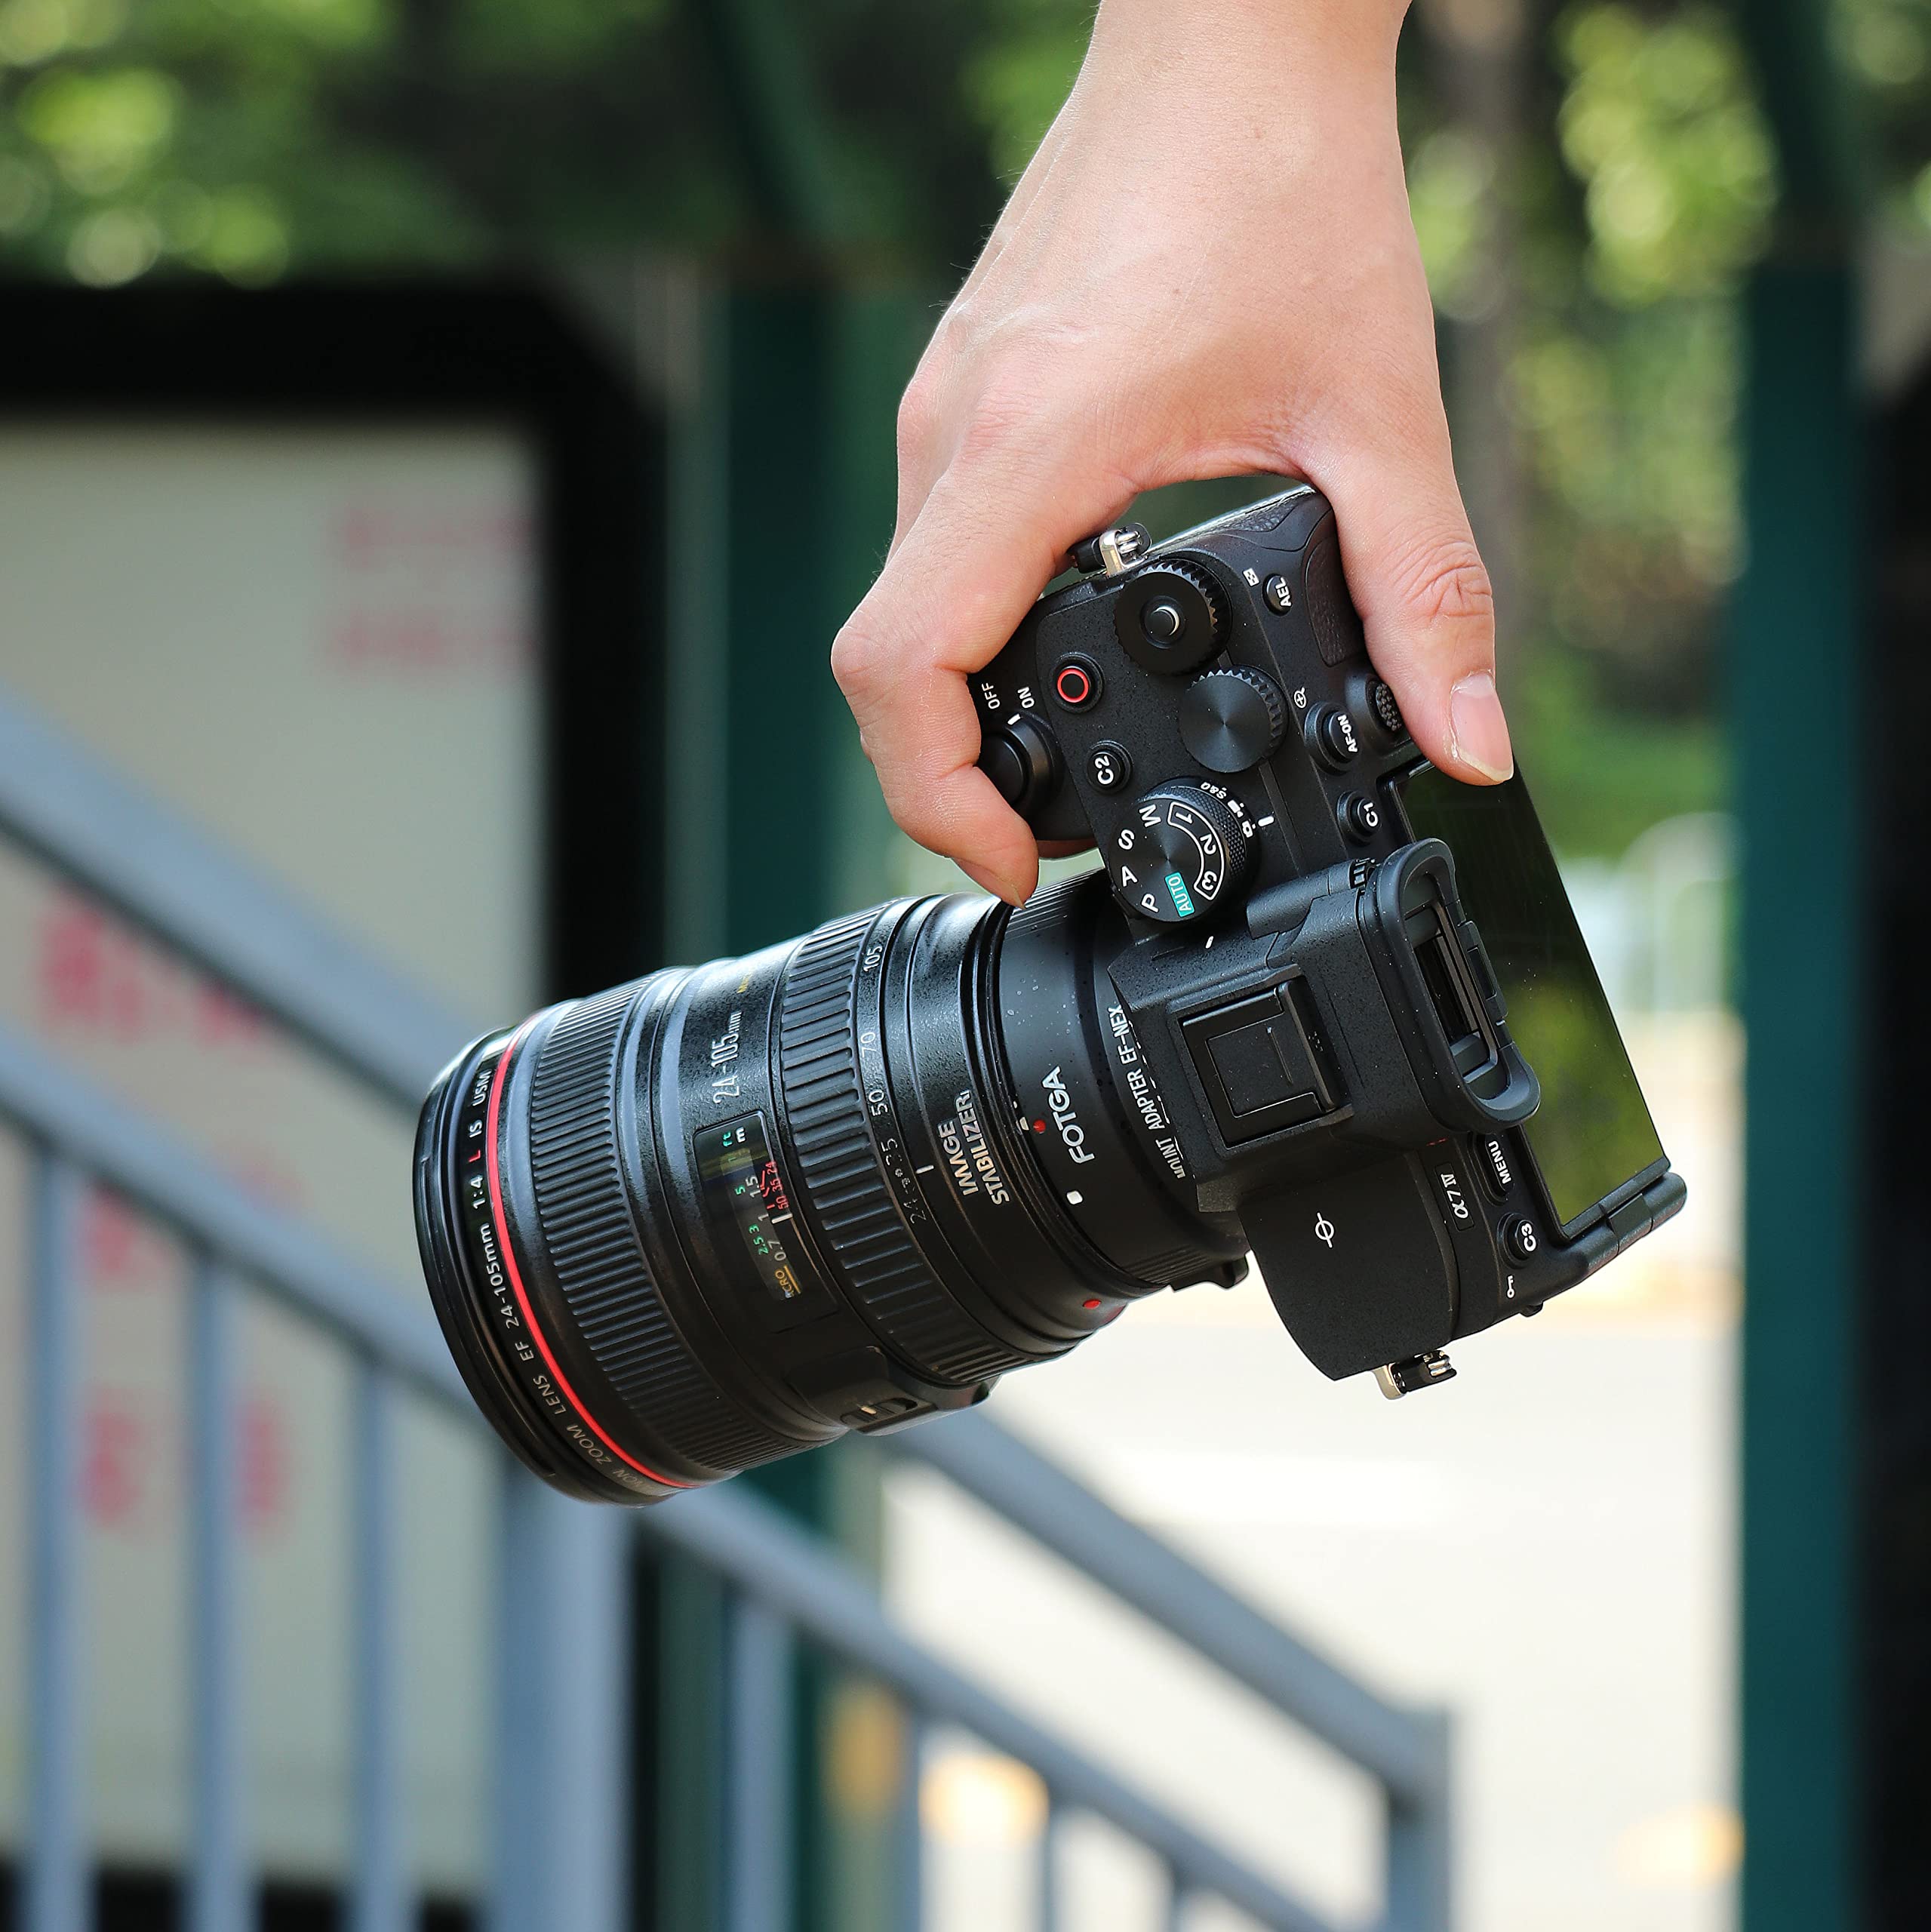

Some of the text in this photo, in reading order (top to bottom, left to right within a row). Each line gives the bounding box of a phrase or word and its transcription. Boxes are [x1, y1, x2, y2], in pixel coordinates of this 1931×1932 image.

[1275, 577, 1291, 607] AEL
[981, 682, 1001, 709] OFF
[1017, 686, 1035, 709] ON
[1337, 714, 1358, 753] AF-ON
[1094, 755, 1115, 785] C2
[1139, 804, 1162, 828] M
[1175, 811, 1193, 824] 1
[1363, 802, 1379, 827] C1
[1118, 829, 1135, 851] S
[1200, 833, 1216, 855] 2
[1121, 866, 1138, 888] A
[1201, 870, 1217, 891] 3
[1141, 893, 1160, 913] P
[1167, 875, 1192, 912] AUTO
[863, 946, 883, 973] 105
[860, 1032, 877, 1058] 70
[1108, 1004, 1138, 1065] EF-NEX
[711, 1011, 742, 1104] 24-105mm
[472, 1069, 493, 1107] USM
[868, 1088, 889, 1117] 50
[1127, 1068, 1165, 1130] ADAPTER
[469, 1118, 483, 1138] IS
[1042, 1065, 1095, 1164] FOTGA
[723, 1131, 733, 1147] ft
[955, 1090, 1010, 1204] STABILIZER
[468, 1149, 481, 1163] L
[936, 1120, 979, 1196] IMAGE
[1488, 1140, 1511, 1185] MENU
[470, 1174, 486, 1209] 1:4
[734, 1185, 746, 1195] 5
[736, 1127, 787, 1261] 0.7 1 1.5 m
[765, 1161, 790, 1210] 50 35 24
[749, 1223, 760, 1234] 3
[1521, 1222, 1537, 1253] C3
[753, 1235, 769, 1255] 2.5
[478, 1222, 520, 1329] 24-105mm
[515, 1340, 534, 1361] EF
[532, 1374, 567, 1415] LENS
[566, 1425, 613, 1465] ZOOM
